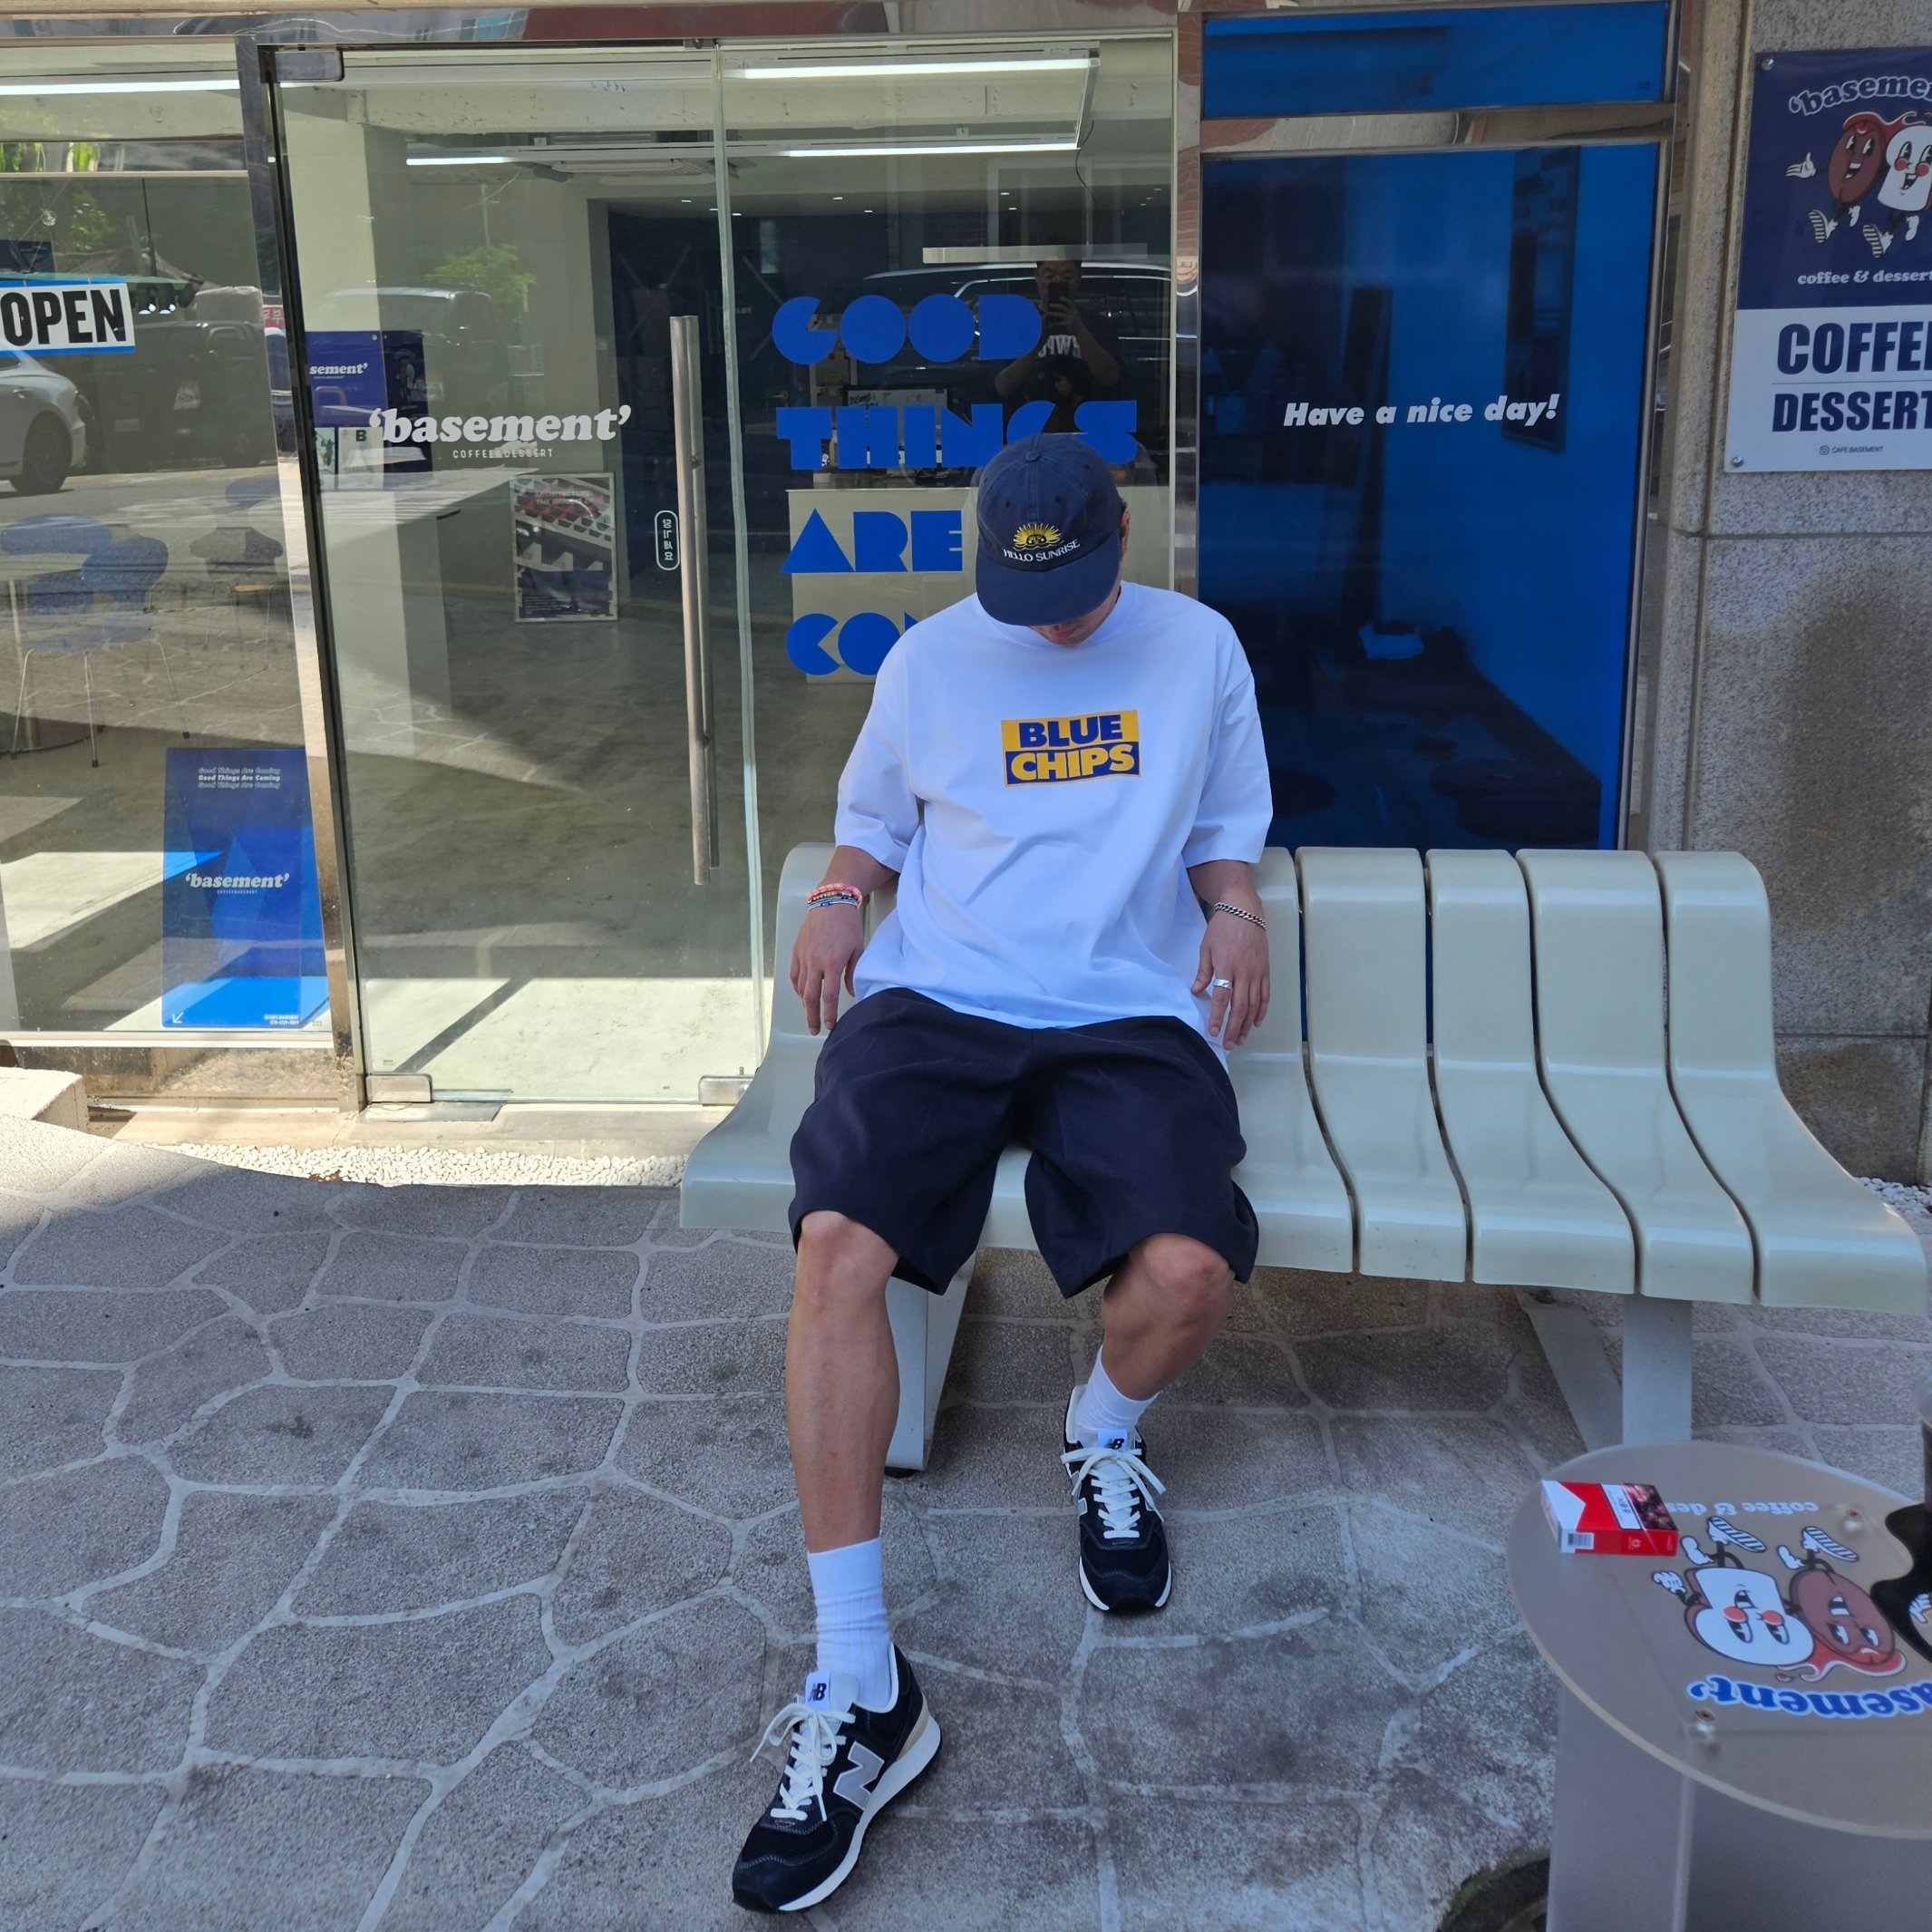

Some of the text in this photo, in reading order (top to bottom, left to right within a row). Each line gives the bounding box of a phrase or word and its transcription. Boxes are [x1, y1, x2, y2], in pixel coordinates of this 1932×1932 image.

[1789, 76, 1932, 116] ‘baseme
[1797, 272, 1849, 285] coffee
[1853, 270, 1869, 283] &
[0, 288, 127, 346] OPEN
[772, 293, 1043, 364] GOOD
[309, 362, 368, 374] sement’
[369, 404, 632, 443] ‘basement’
[1283, 393, 1560, 427] Have a nice day!
[781, 508, 963, 573] ARE
[1003, 539, 1081, 562] HELLO SUNRISE
[786, 612, 918, 675] CO
[1019, 714, 1122, 748] BLUE
[1011, 743, 1135, 781] CHIPS
[185, 872, 290, 888] ‘basement’
[1664, 1501, 1707, 1516] des
[1741, 1501, 1820, 1515] coffee
[1686, 1675, 1932, 1719] asement’
